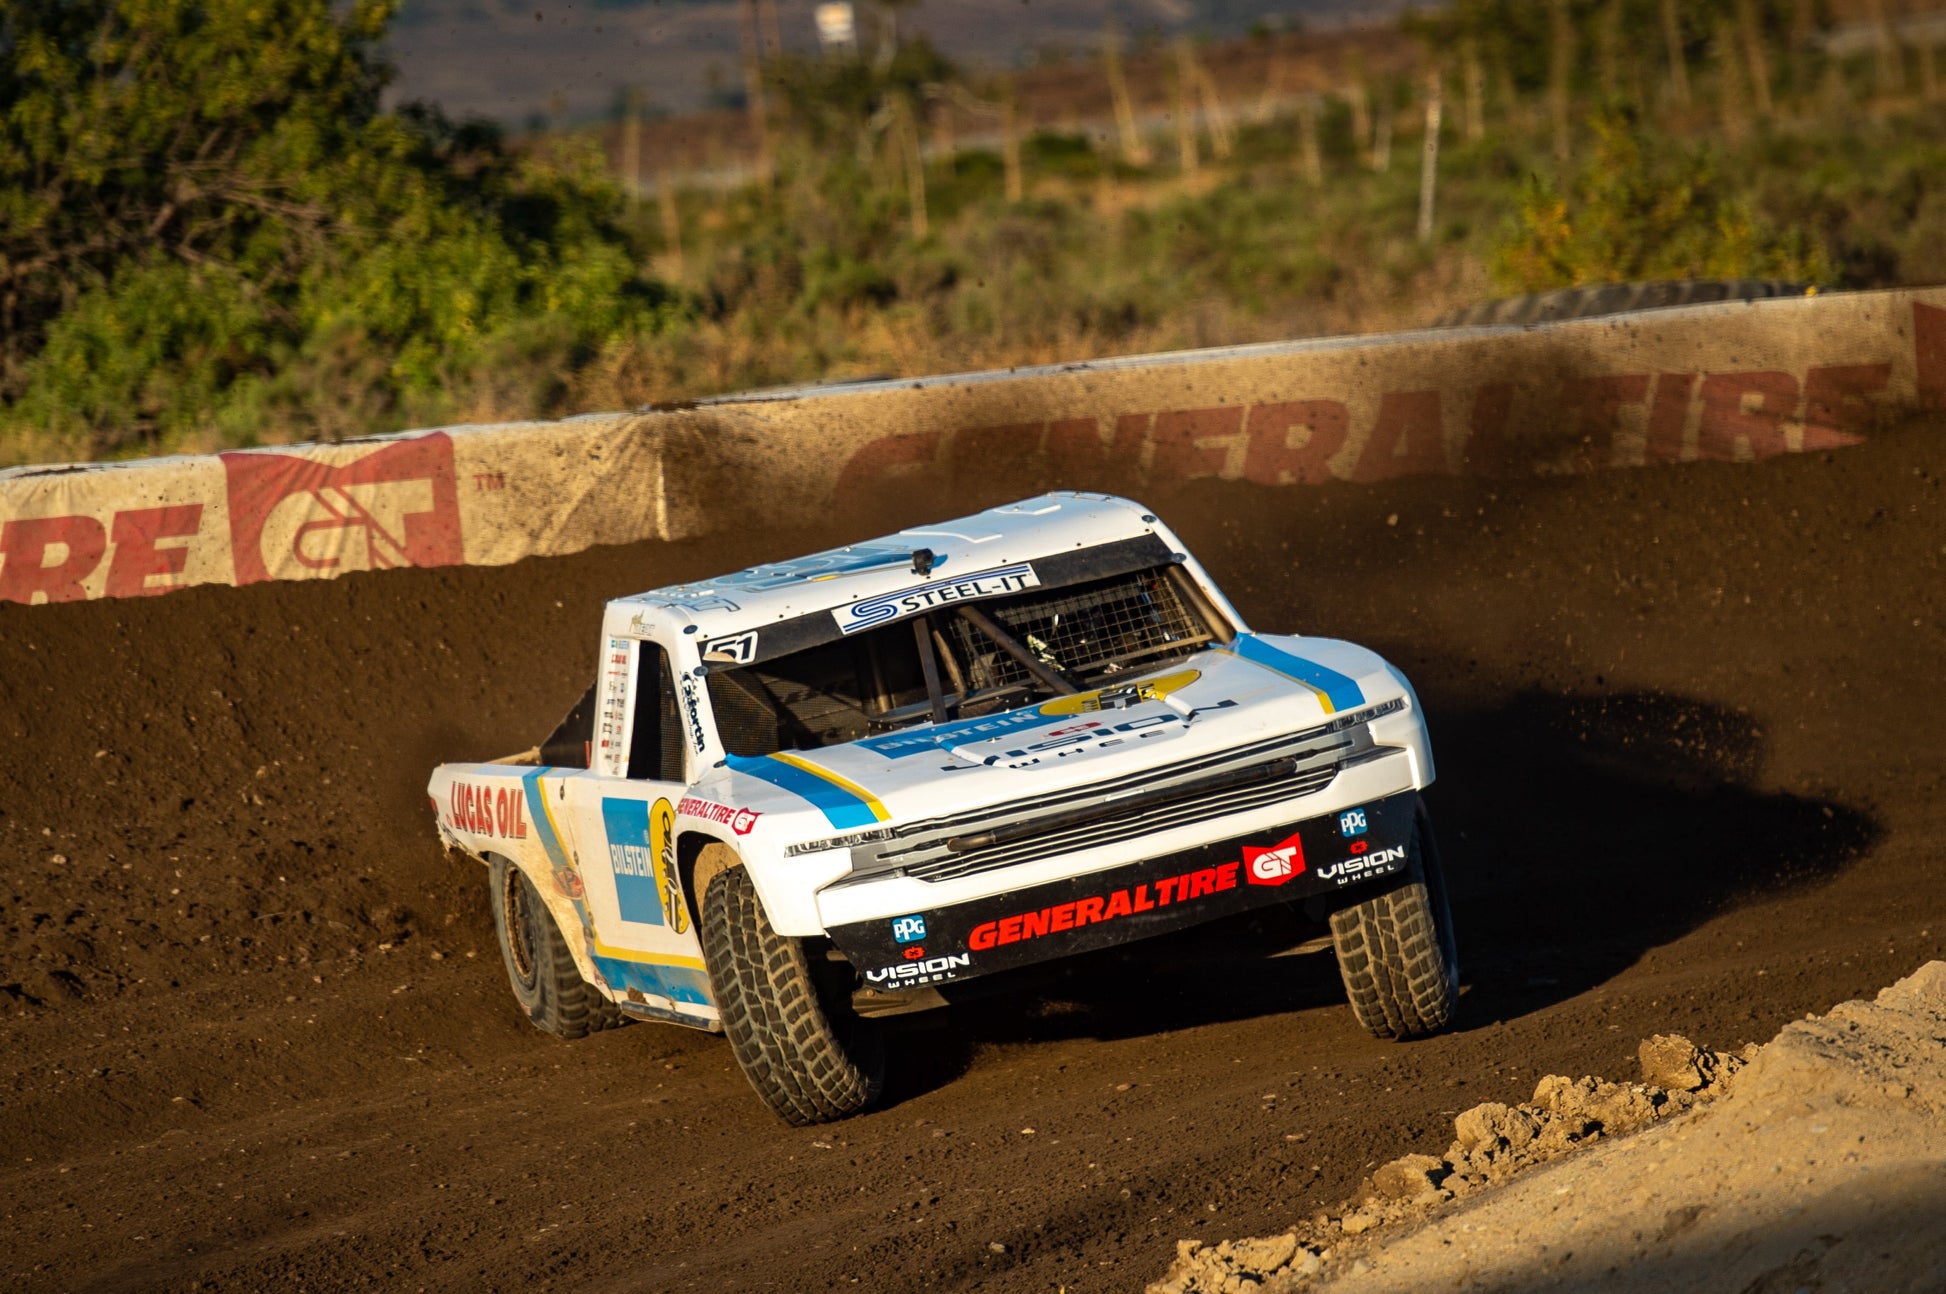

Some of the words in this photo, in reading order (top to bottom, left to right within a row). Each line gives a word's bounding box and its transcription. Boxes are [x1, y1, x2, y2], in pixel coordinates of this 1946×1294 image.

[901, 574, 1028, 612] STEEL-IT
[451, 781, 494, 838] LUCAS
[496, 787, 527, 840] OIL
[1341, 812, 1367, 834] PPG
[610, 844, 655, 878] BILSTEIN
[1317, 845, 1405, 879] VISION
[1337, 865, 1395, 885] WHEEL
[893, 918, 925, 941] PPG
[866, 953, 970, 982] VISION
[888, 972, 956, 989] WHEEL
